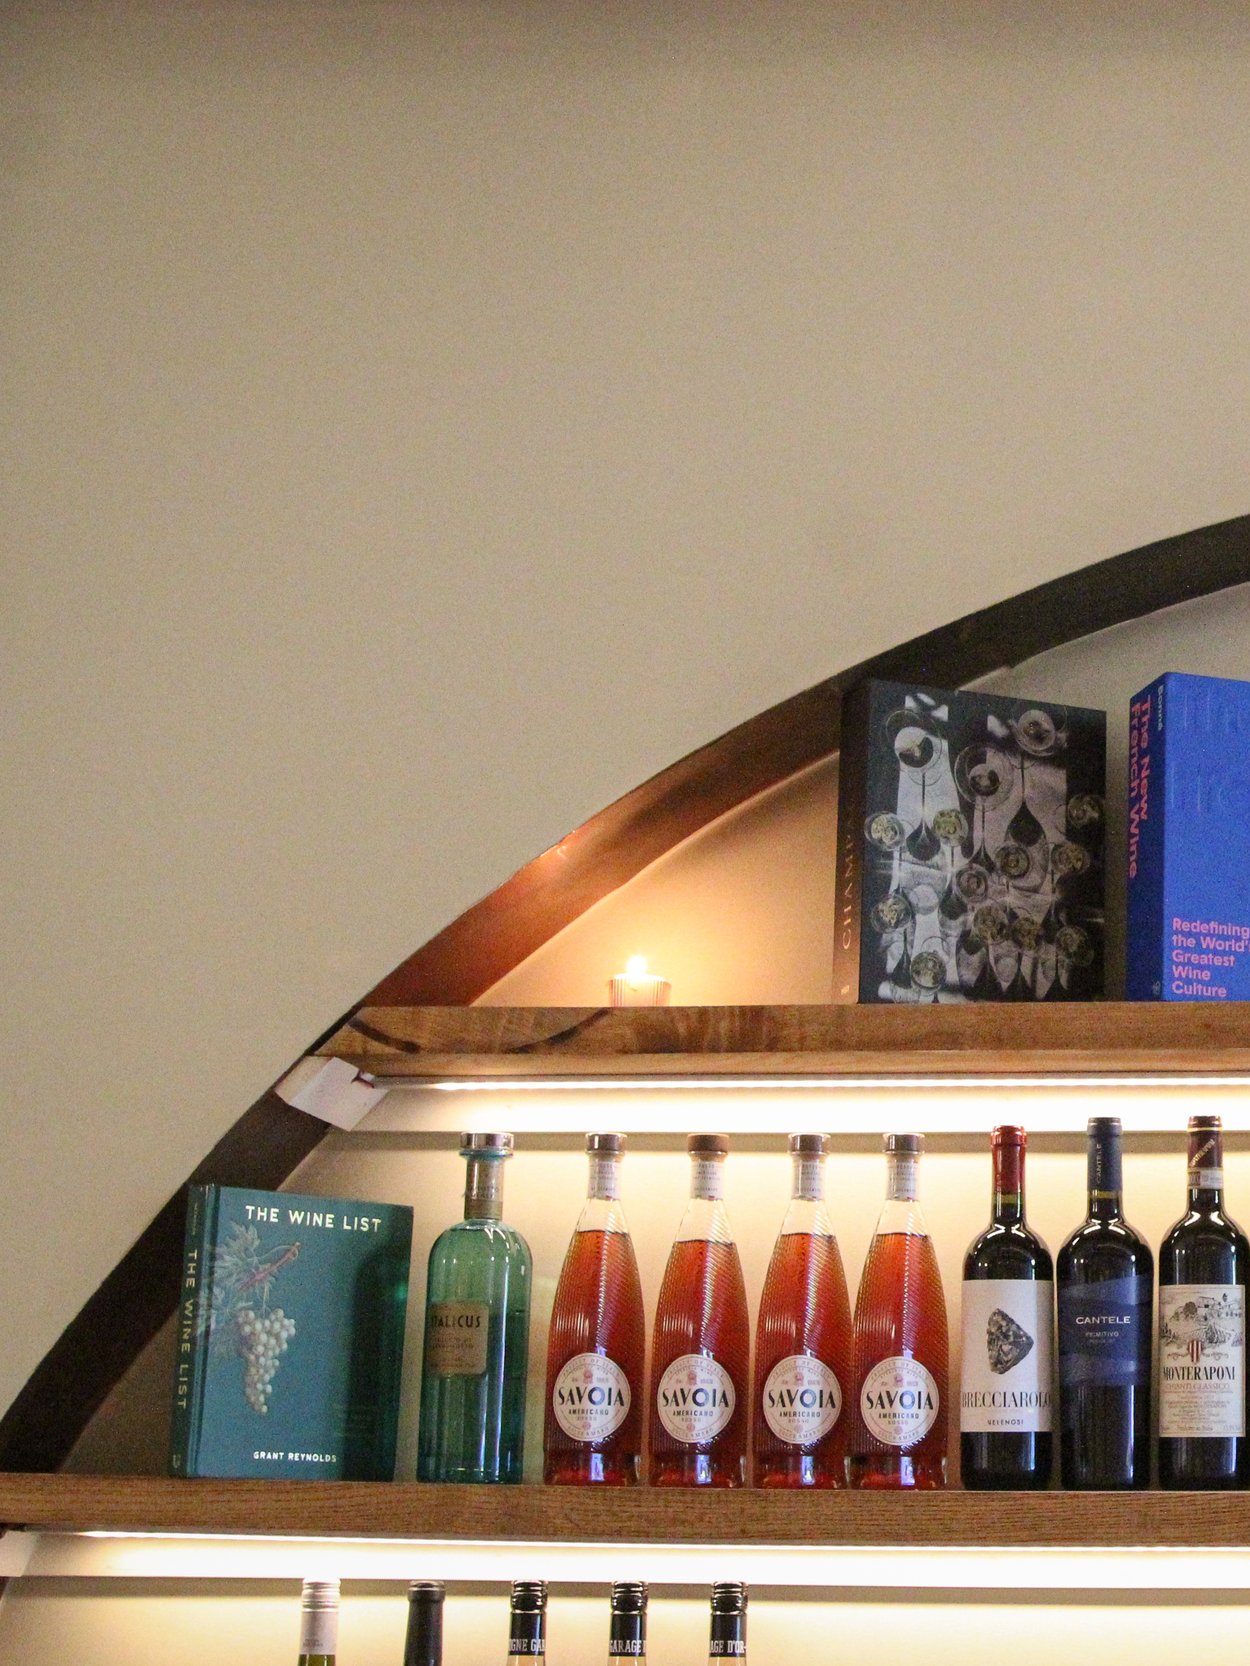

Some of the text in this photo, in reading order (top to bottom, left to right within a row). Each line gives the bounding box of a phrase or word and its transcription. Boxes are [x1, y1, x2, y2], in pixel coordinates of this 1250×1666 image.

[1140, 695, 1150, 821] The New
[1129, 702, 1141, 880] French Wine
[1172, 917, 1250, 939] Redefining
[1172, 934, 1196, 947] the
[1172, 949, 1236, 966] Greatest
[1172, 965, 1211, 980] Wine
[1172, 981, 1227, 997] Culture
[245, 1205, 382, 1232] THE WINE LIST
[186, 1249, 198, 1288] THE
[181, 1300, 194, 1353] WINE
[1075, 1316, 1131, 1325] CANTELE
[1163, 1366, 1235, 1381] MONTERAPONI
[177, 1364, 189, 1409] LIST
[558, 1386, 625, 1408] SAVOIA
[662, 1387, 730, 1408] SAVOIA
[768, 1388, 837, 1409] SAVOIA
[865, 1390, 934, 1410] SAVOIA
[568, 1408, 609, 1416] AMERICANO
[253, 1451, 337, 1462] GRANT REYNOLDS
